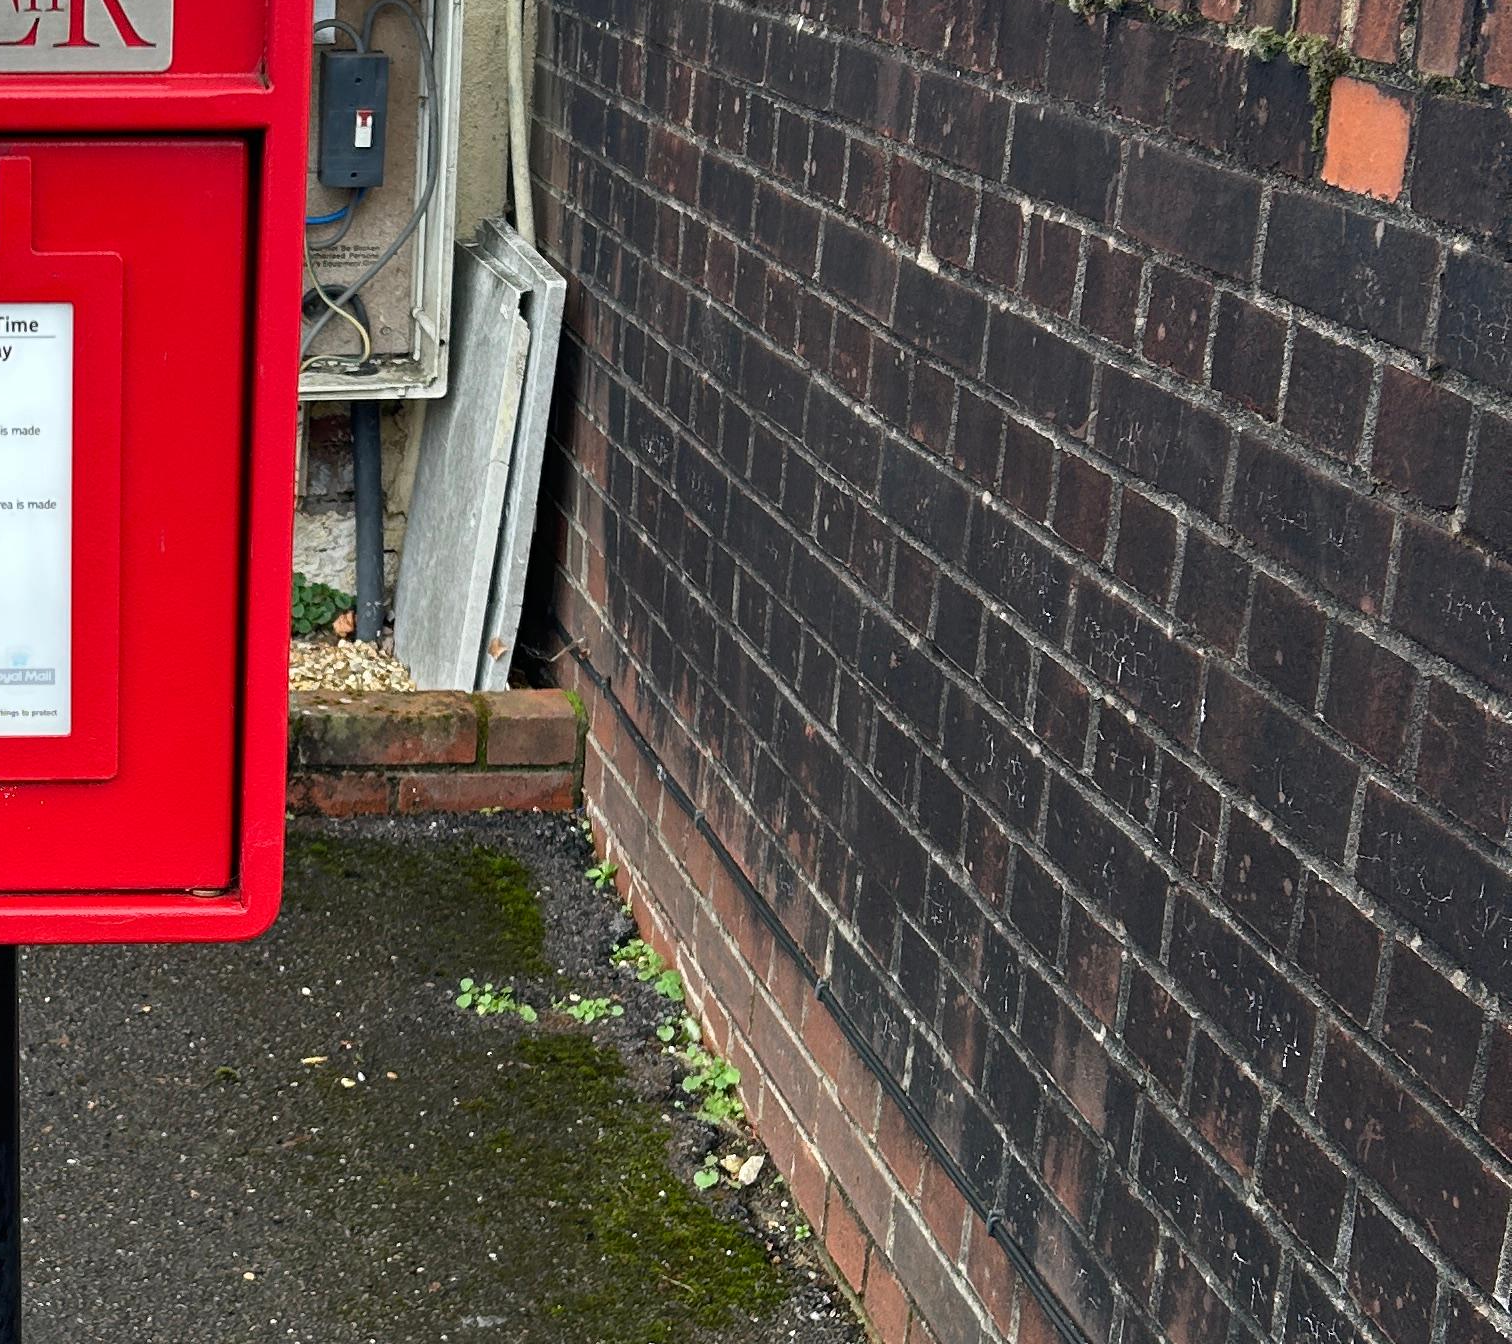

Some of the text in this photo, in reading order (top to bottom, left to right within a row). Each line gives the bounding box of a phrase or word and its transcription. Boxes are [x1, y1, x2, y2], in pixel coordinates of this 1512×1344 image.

[0, 425, 8, 436] is
[12, 425, 40, 436] made
[16, 499, 24, 509] is
[28, 499, 56, 509] made
[24, 670, 52, 682] Mail
